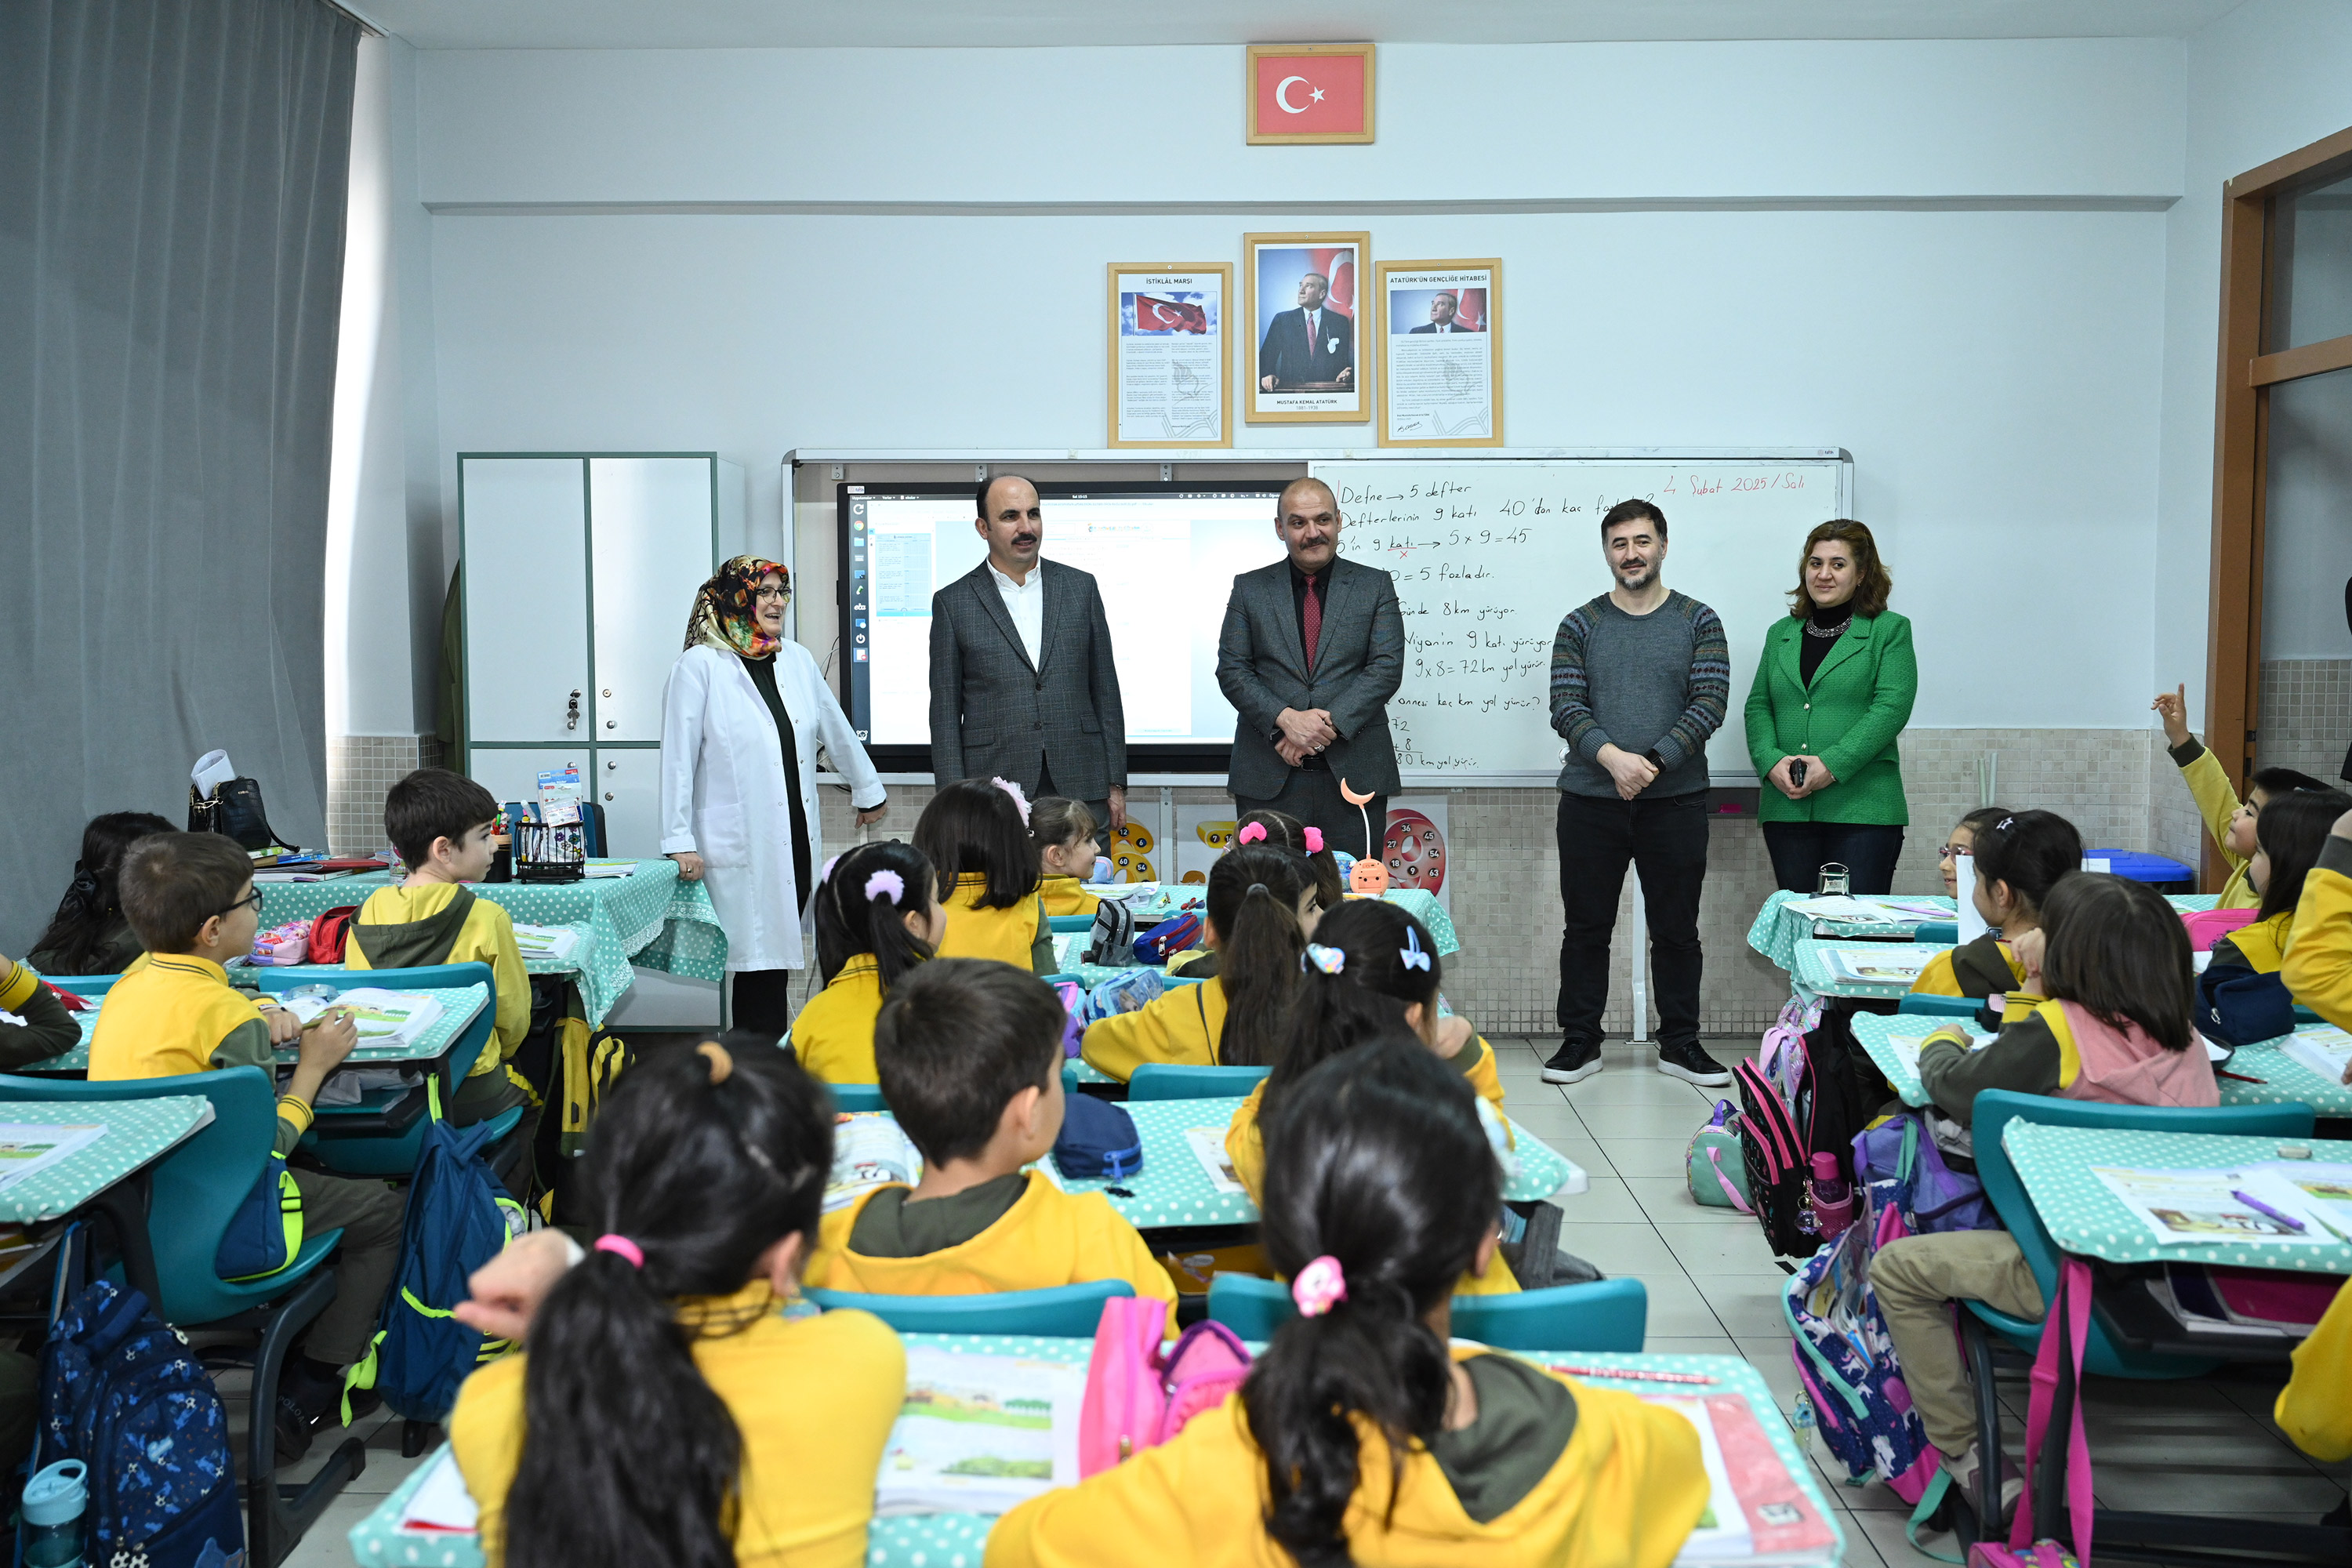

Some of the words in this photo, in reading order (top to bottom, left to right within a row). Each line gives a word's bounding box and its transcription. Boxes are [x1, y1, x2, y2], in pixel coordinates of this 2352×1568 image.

[1428, 275, 1459, 284] GENÇLİĞE
[1340, 485, 1383, 504] Defne
[1409, 484, 1419, 498] 5
[1425, 481, 1472, 499] defter
[1341, 510, 1420, 528] Defterlerinin
[1433, 507, 1443, 521] 9
[1451, 505, 1477, 519] katı
[1373, 539, 1381, 551] 9
[1390, 535, 1414, 548] katı
[1449, 529, 1459, 546] 5
[1479, 529, 1490, 545] 9
[1507, 527, 1533, 544] 45
[1420, 567, 1432, 580] 5
[1467, 630, 1477, 648] 9
[1415, 659, 1424, 677] 9
[1436, 661, 1445, 677] 8
[1501, 659, 1518, 682] yol
[1458, 693, 1474, 706] km
[1481, 694, 1497, 713] yol
[1391, 718, 1410, 731] 72
[1405, 738, 1412, 750] 8
[1396, 753, 1414, 765] 80
[1420, 753, 1435, 766] km
